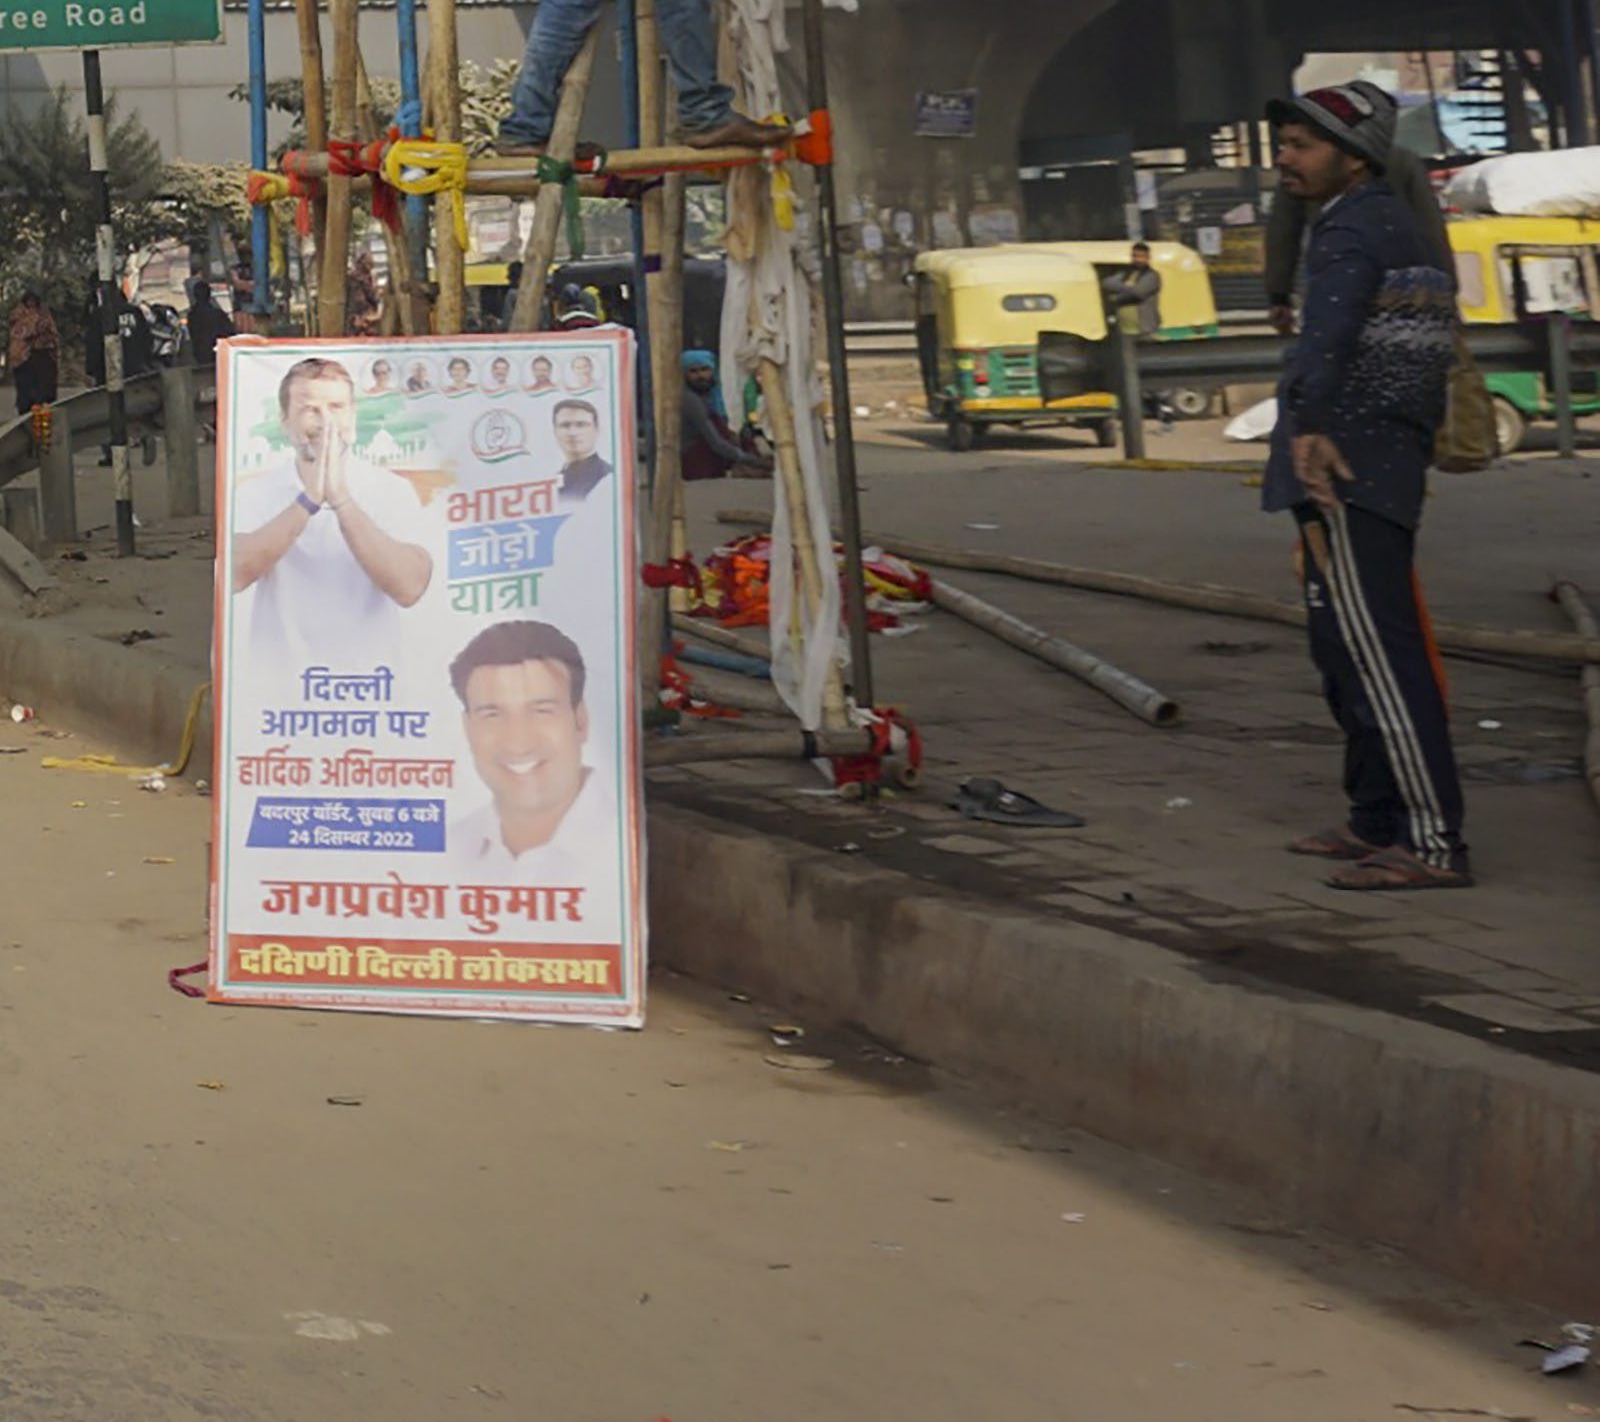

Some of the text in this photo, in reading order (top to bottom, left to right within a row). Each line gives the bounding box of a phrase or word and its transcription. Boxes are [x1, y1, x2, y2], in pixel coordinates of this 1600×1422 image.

[65, 0, 146, 27] Road
[447, 479, 557, 523] भारत
[456, 523, 540, 568] जोड़ो
[447, 572, 543, 614] यात्रा
[300, 666, 394, 701] दिल्ली
[261, 709, 430, 738] आगमन पर
[236, 744, 455, 788] हार्दिक अभिनन्दन
[398, 808, 409, 821] 6
[288, 830, 310, 845] 24
[373, 831, 415, 847] 2022
[260, 871, 585, 934] जगप्रवेश कुमार
[238, 943, 610, 985] दक्षिणी दिल्ली लोकसभा
